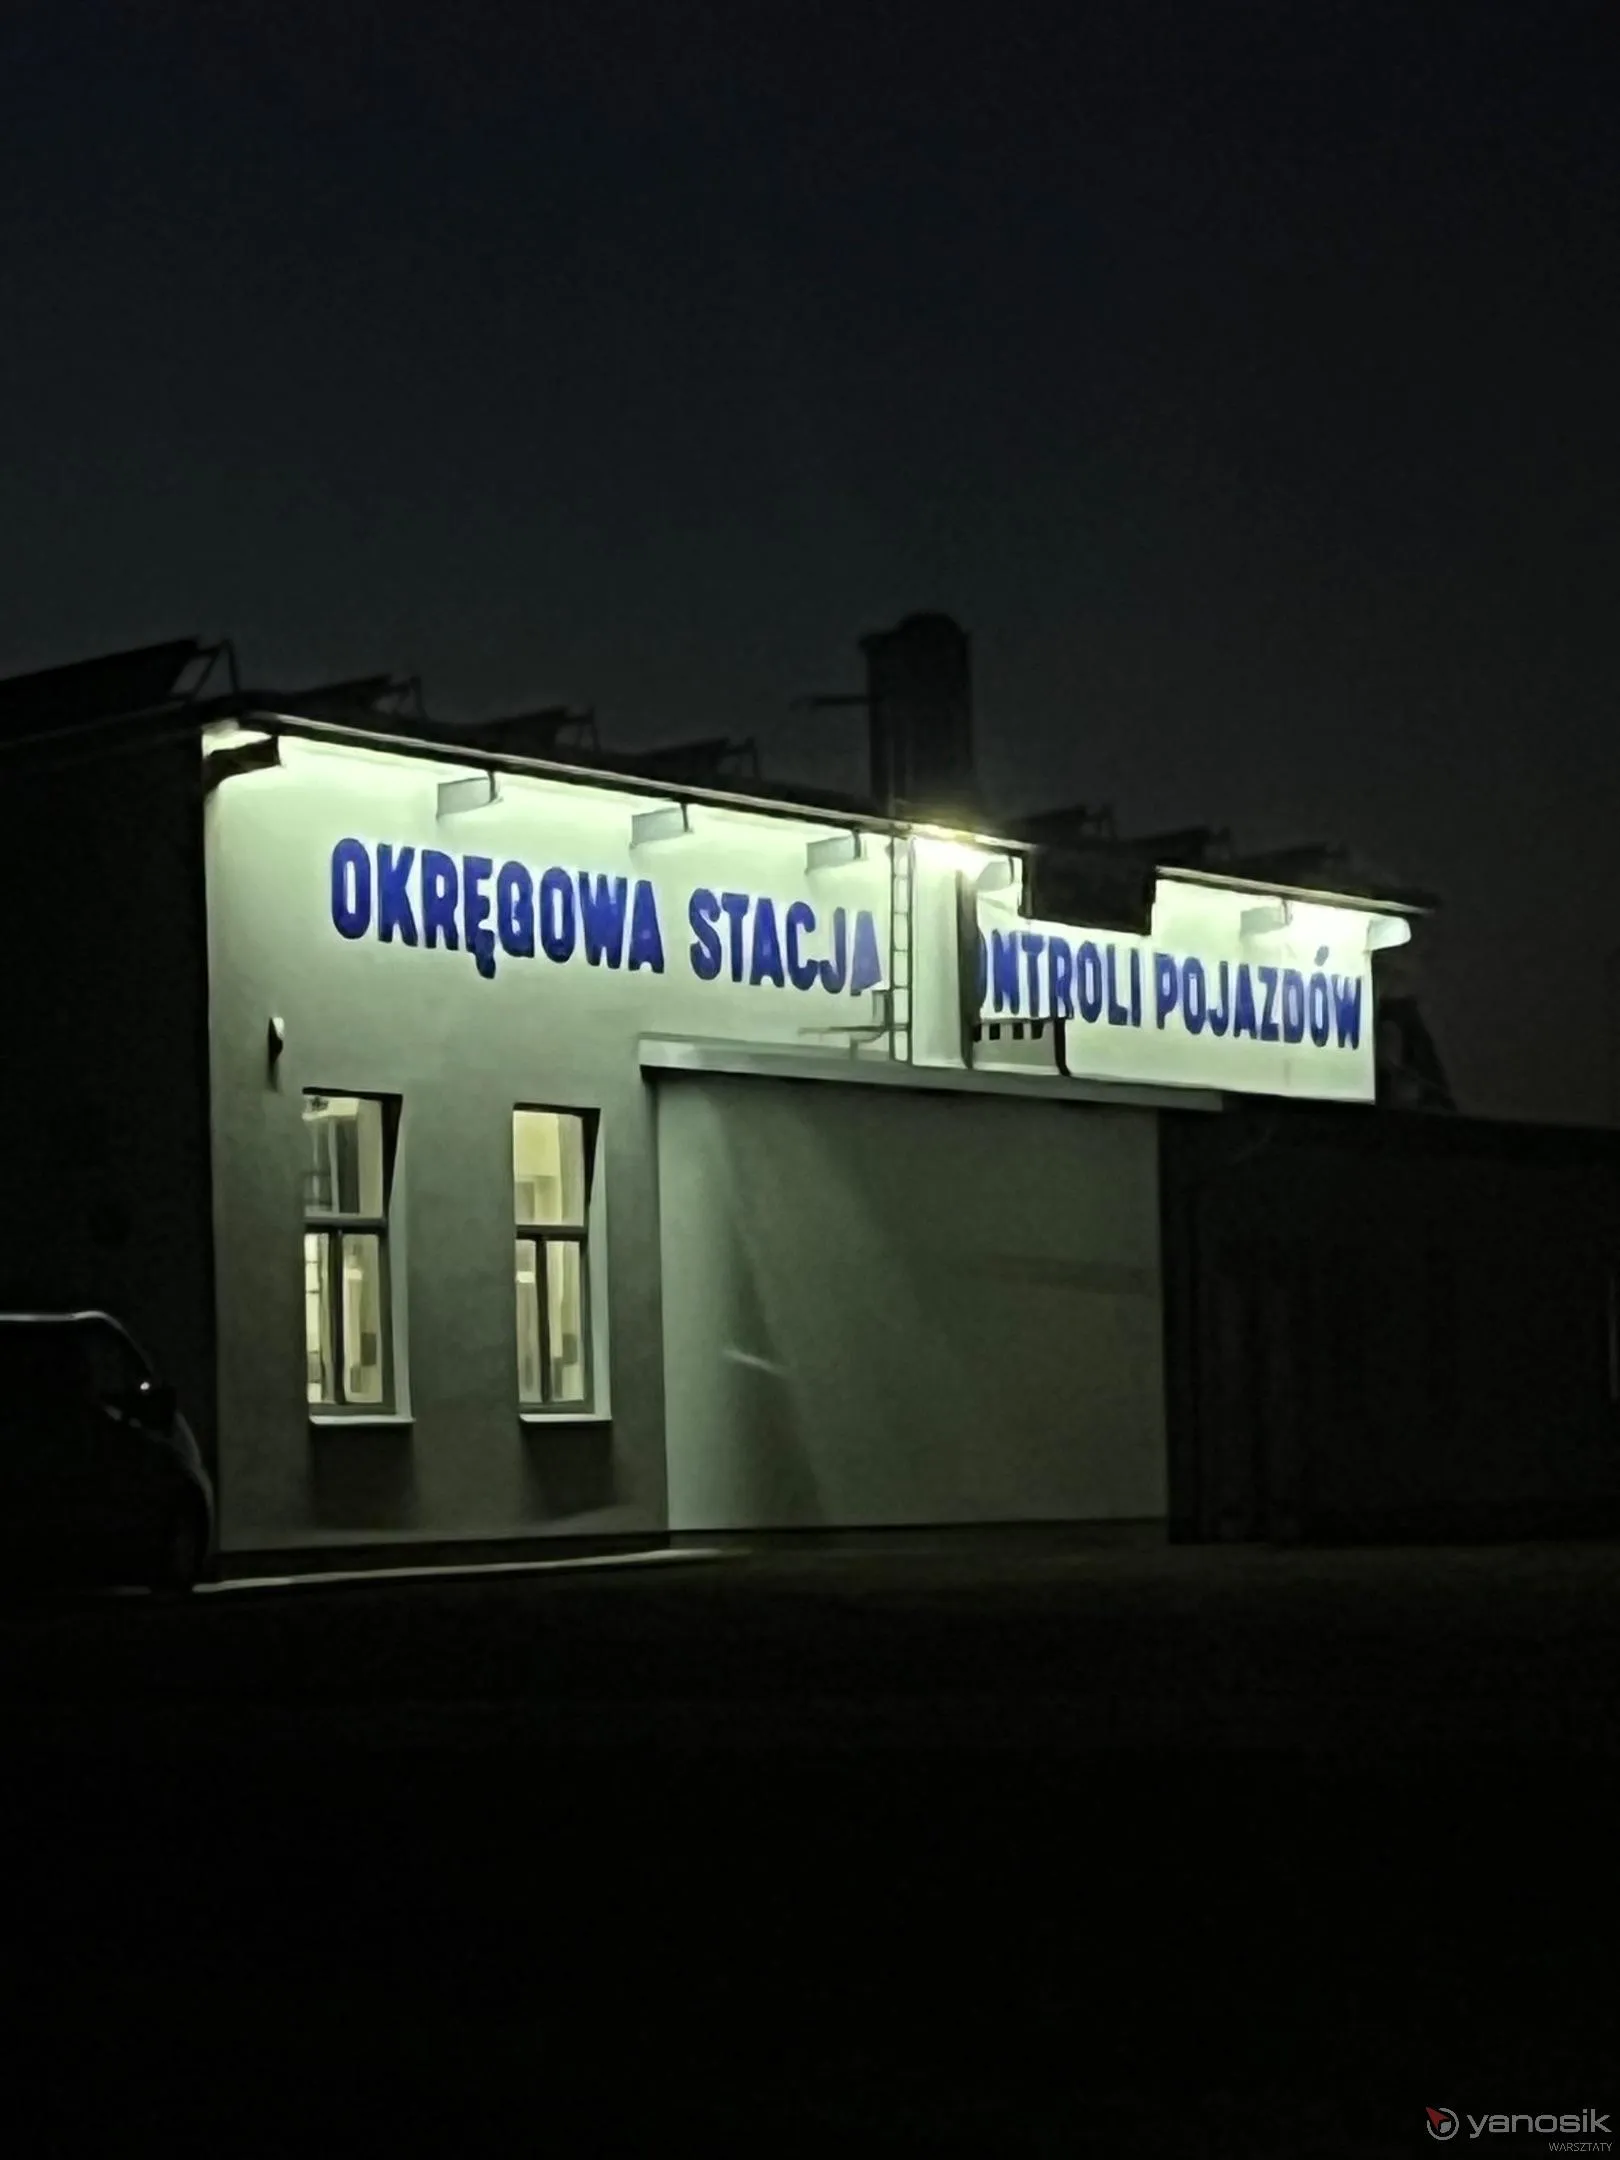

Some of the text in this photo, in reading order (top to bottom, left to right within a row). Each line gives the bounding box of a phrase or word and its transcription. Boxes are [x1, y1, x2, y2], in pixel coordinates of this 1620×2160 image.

[331, 838, 664, 979] OKRĘGOWA
[689, 888, 882, 996] STACJA
[1154, 946, 1361, 1049] POJAZDÓW
